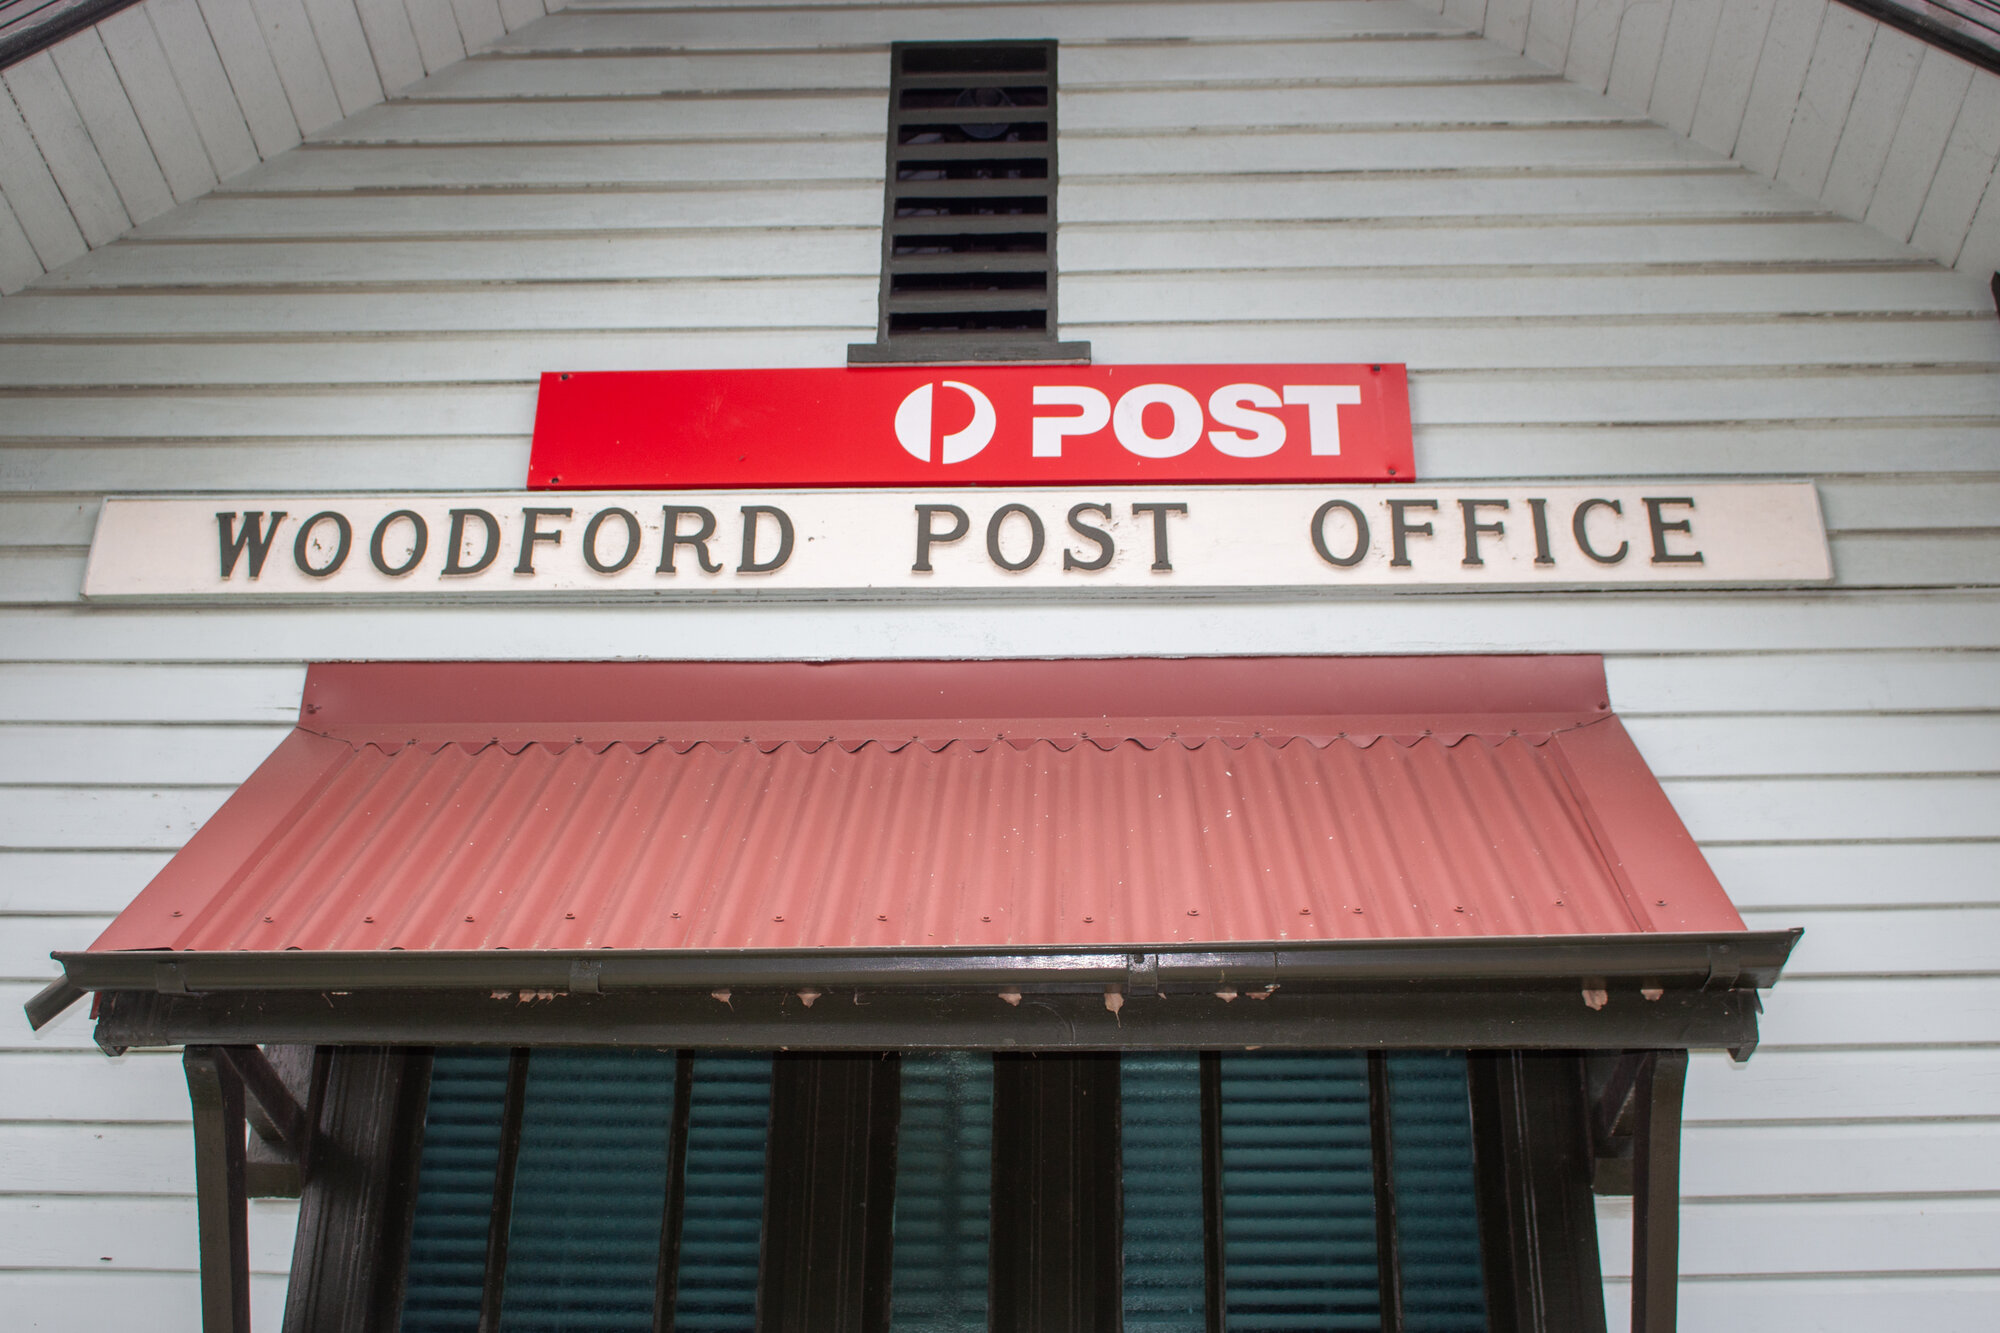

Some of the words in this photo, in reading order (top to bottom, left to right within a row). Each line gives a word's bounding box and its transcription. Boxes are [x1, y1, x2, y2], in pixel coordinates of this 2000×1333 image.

[1031, 384, 1363, 459] POST
[215, 507, 795, 579] WOODFORD
[911, 502, 1188, 574] POST
[1311, 497, 1705, 567] OFFICE
